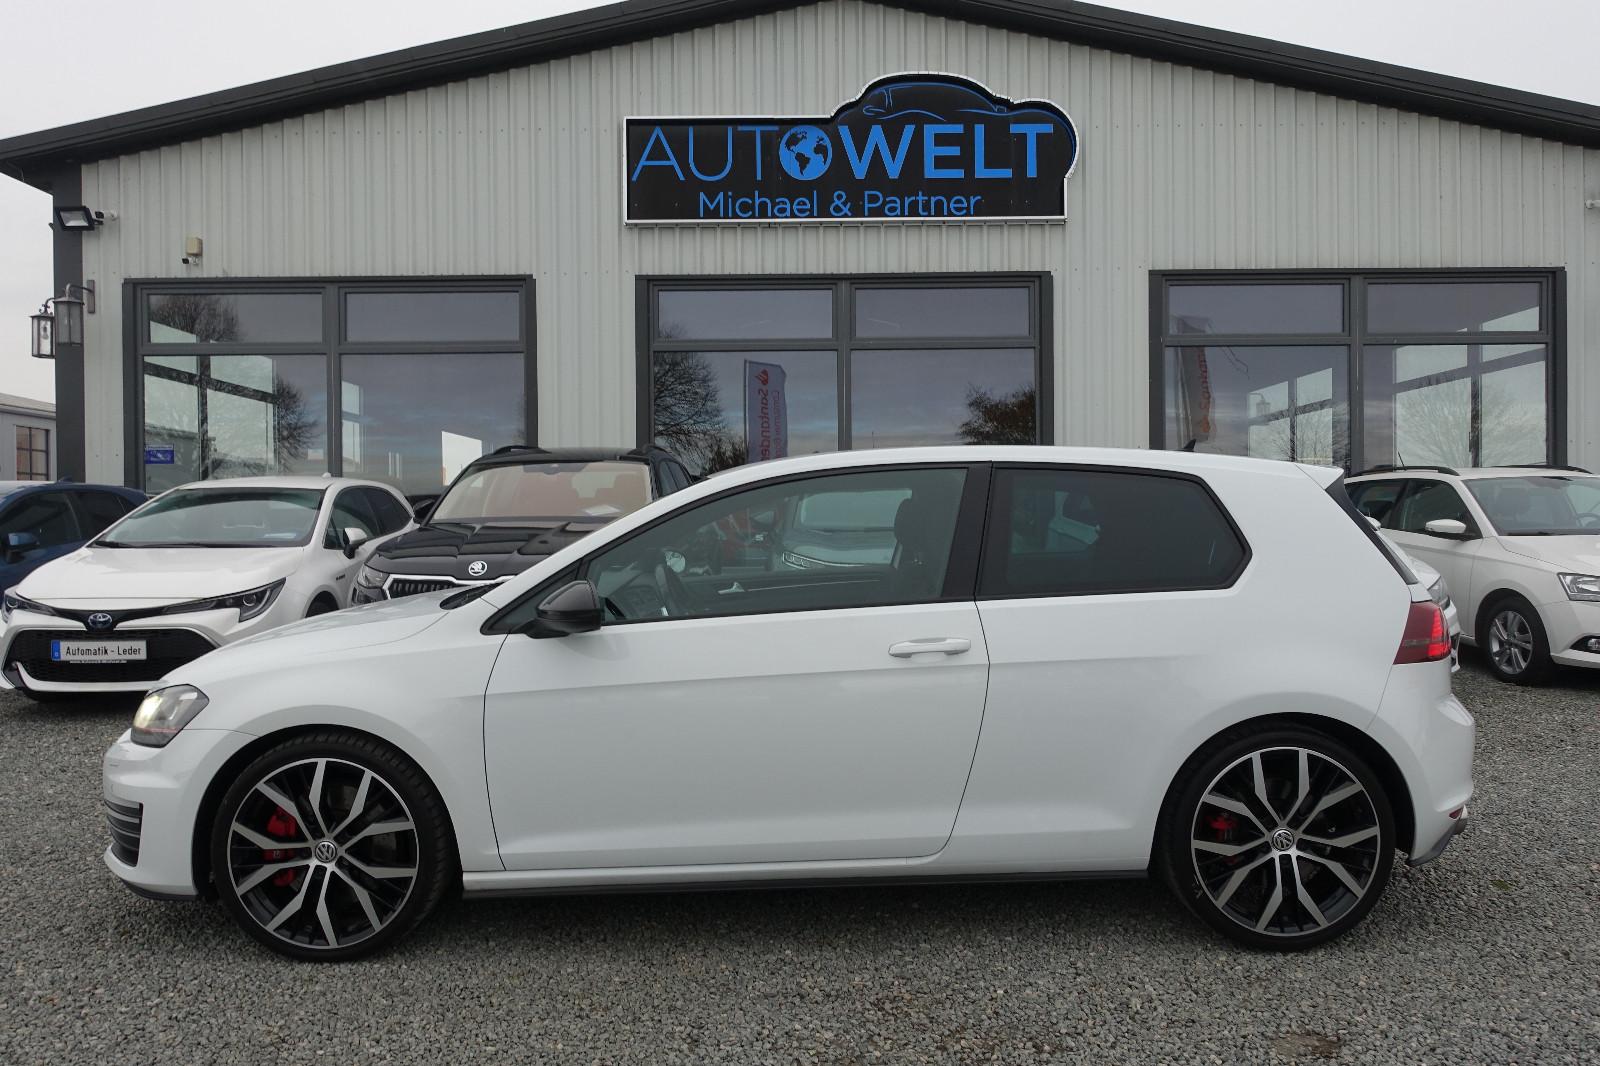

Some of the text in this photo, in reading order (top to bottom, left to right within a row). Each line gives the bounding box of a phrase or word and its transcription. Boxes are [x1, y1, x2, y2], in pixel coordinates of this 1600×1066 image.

[699, 190, 982, 218] Michael & Partner
[65, 646, 109, 656] Automatik
[117, 646, 142, 656] Leder
